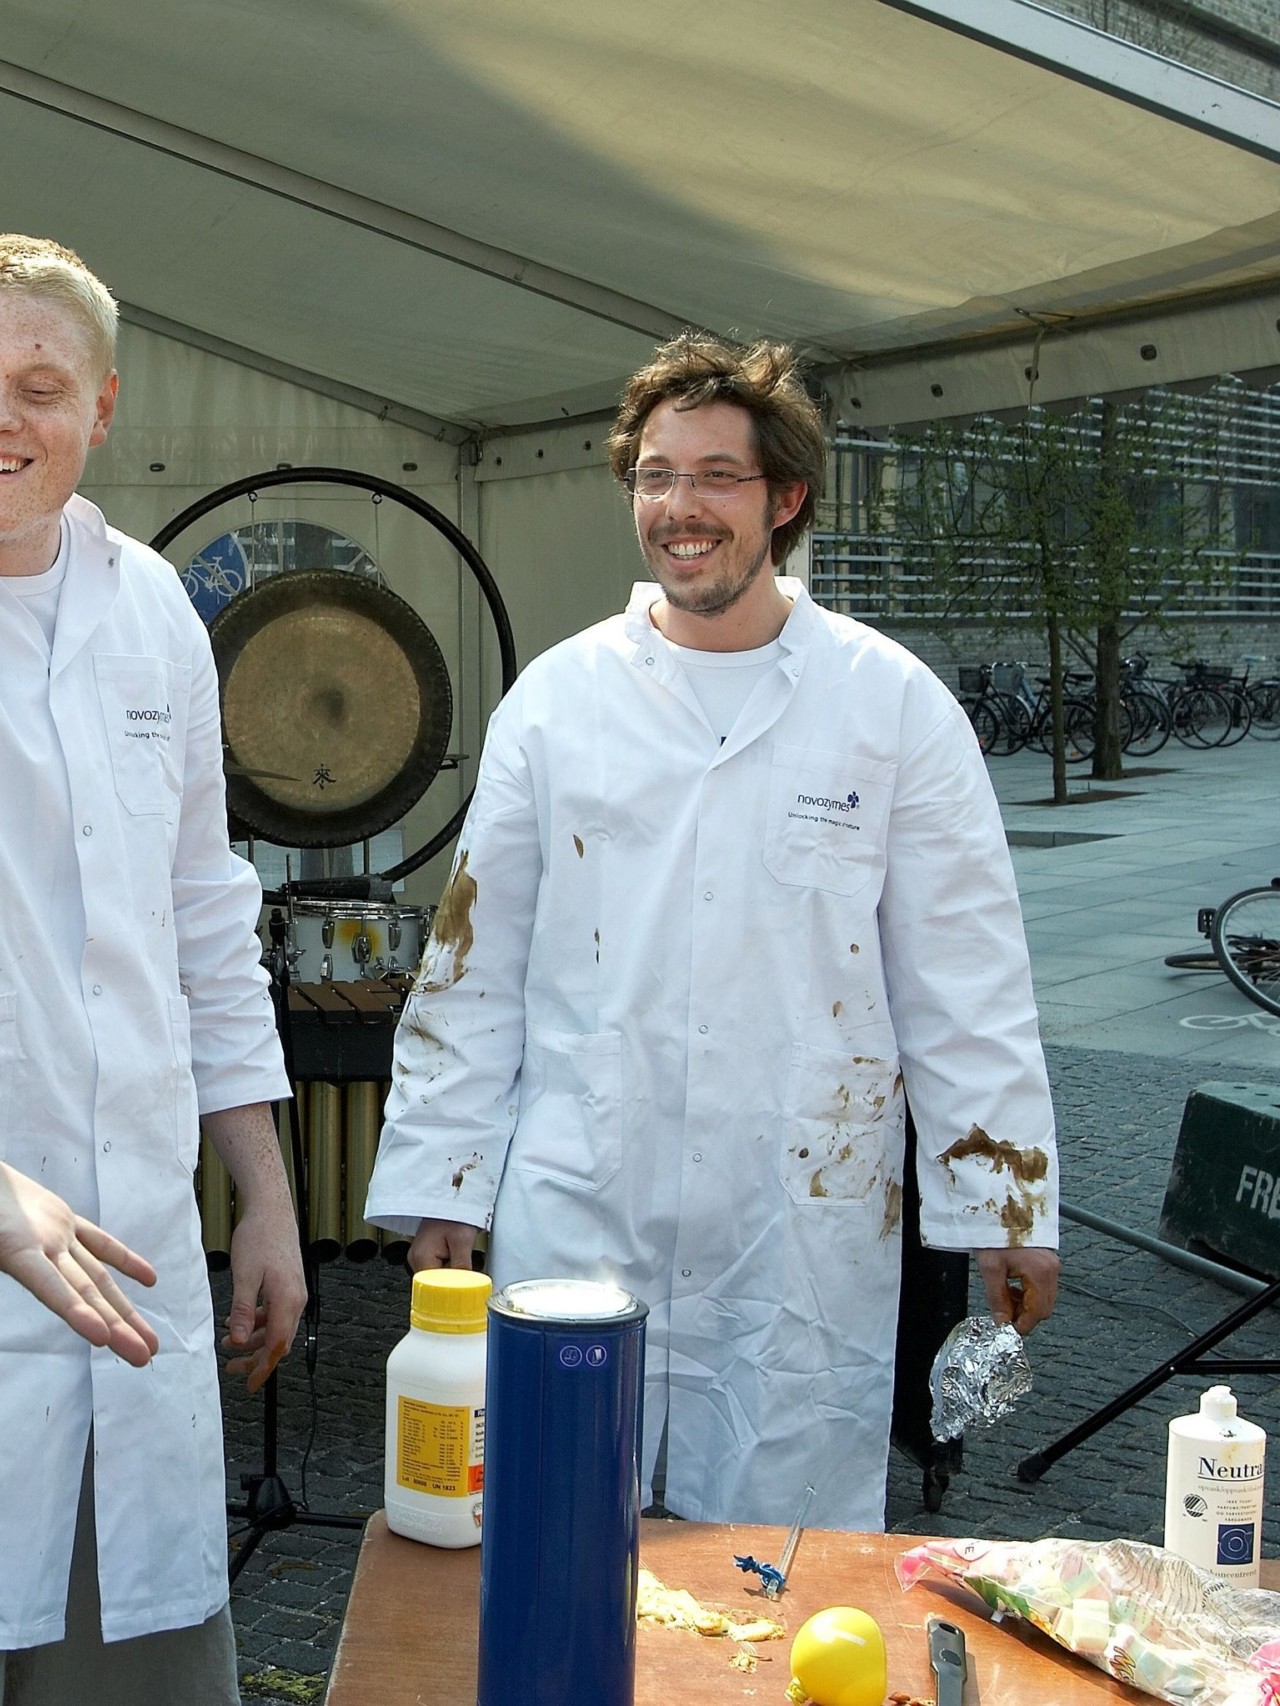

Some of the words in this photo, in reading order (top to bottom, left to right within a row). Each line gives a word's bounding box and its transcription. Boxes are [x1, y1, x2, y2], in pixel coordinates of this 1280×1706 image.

[797, 794, 850, 812] novozymes
[788, 811, 819, 822] Unlocking
[1198, 1456, 1264, 1478] Neutra
